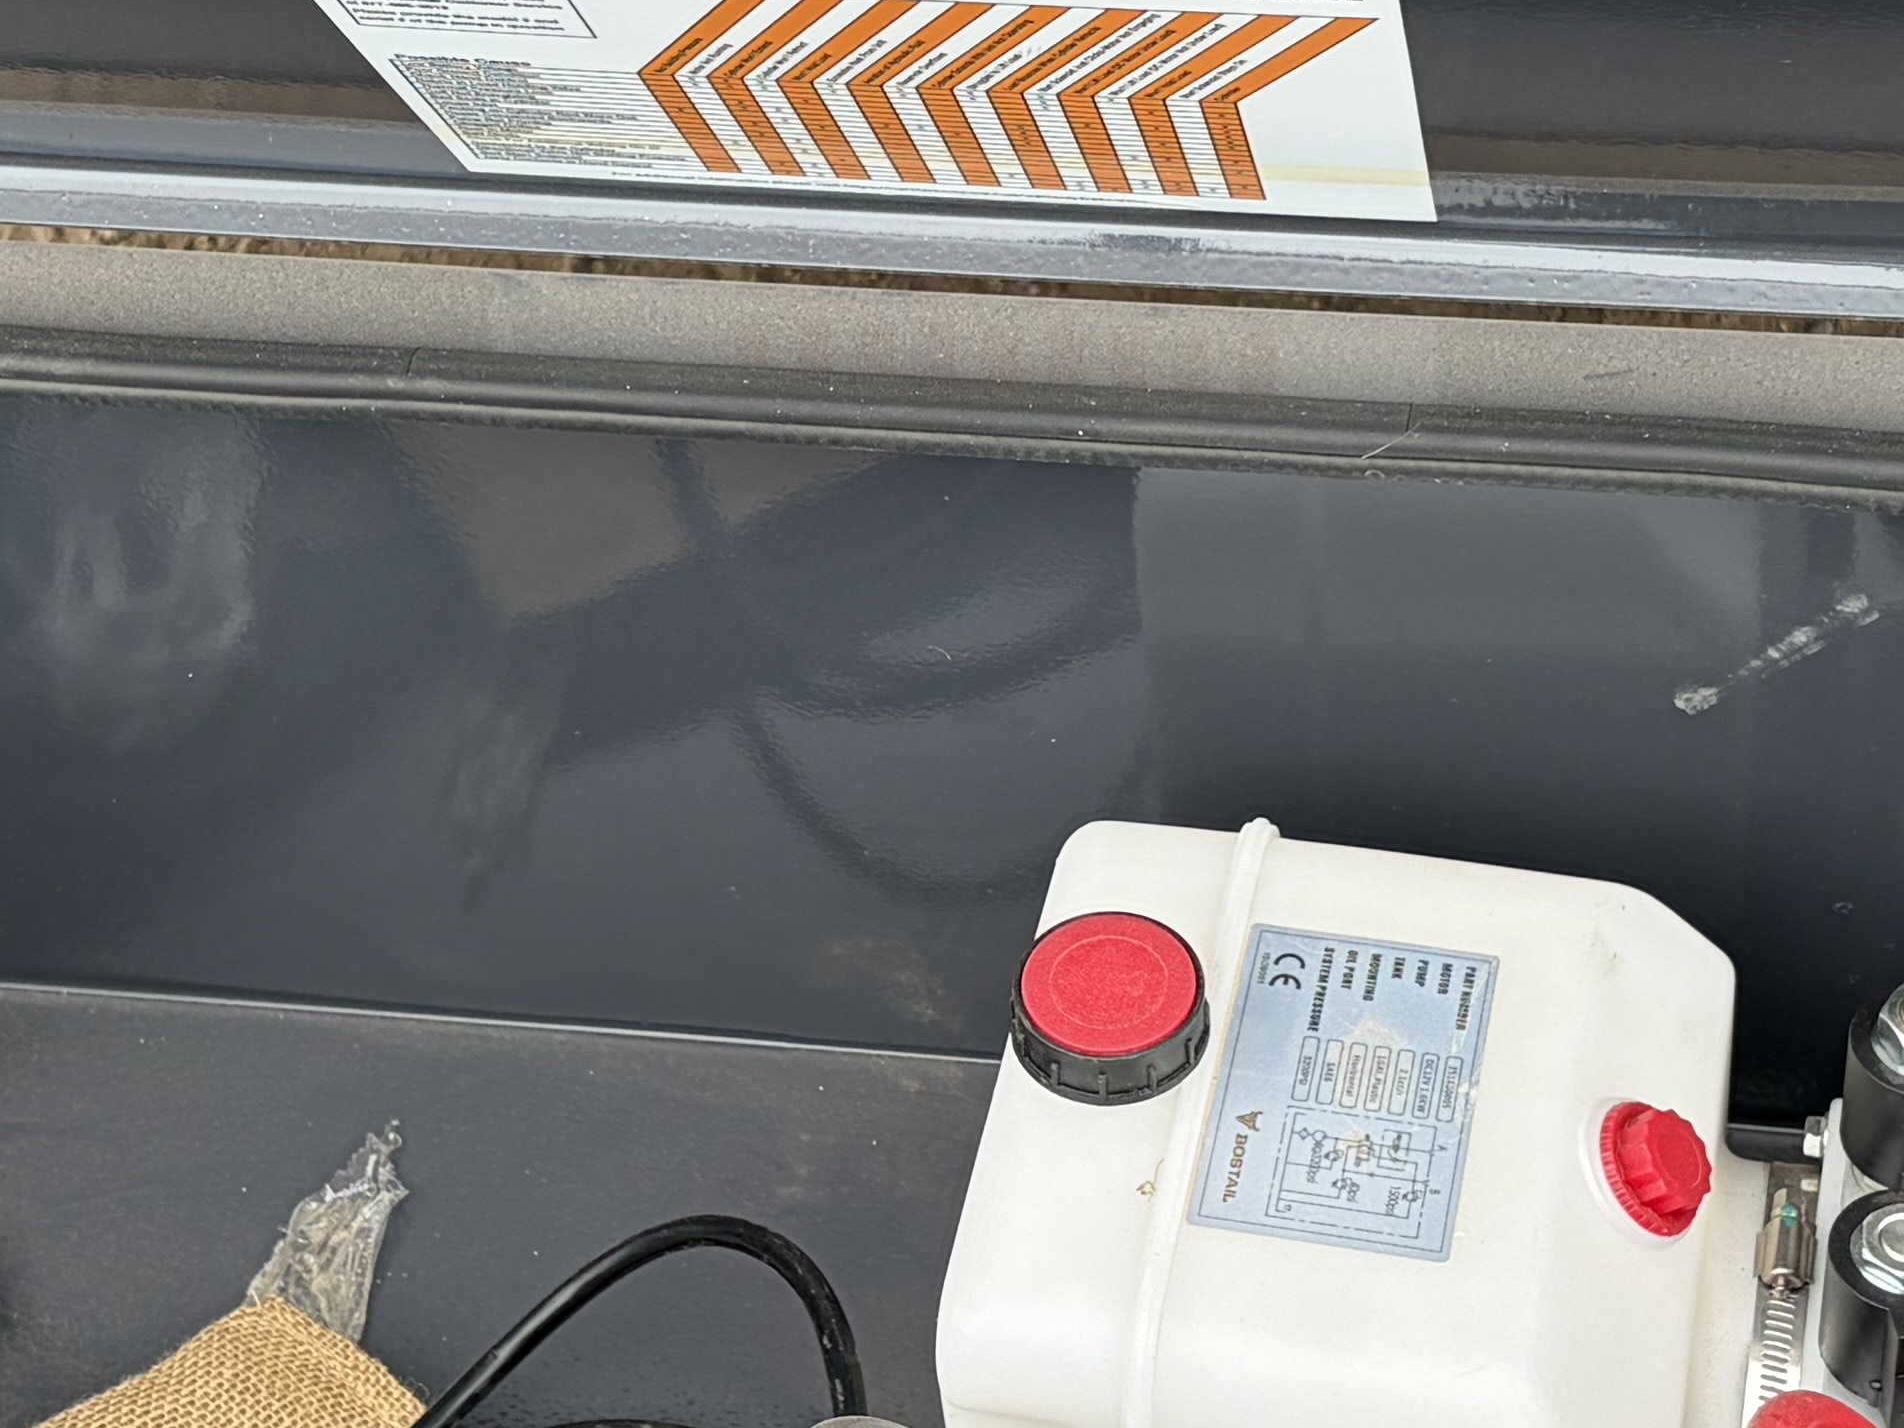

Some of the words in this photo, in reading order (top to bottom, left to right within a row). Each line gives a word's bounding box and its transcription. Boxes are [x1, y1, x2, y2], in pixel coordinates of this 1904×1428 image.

[1317, 946, 1335, 984] SYSTEM
[1345, 949, 1359, 964] OIL
[1391, 956, 1406, 980] TANK
[1340, 965, 1356, 991] PORT
[1362, 953, 1383, 1002] MOUNTING
[1414, 959, 1430, 988] PUMP
[1437, 962, 1454, 996] MOTOR
[1461, 966, 1477, 990] PART
[1306, 984, 1328, 1033] PRESSURE
[1222, 1133, 1249, 1204] BOSTAIL
